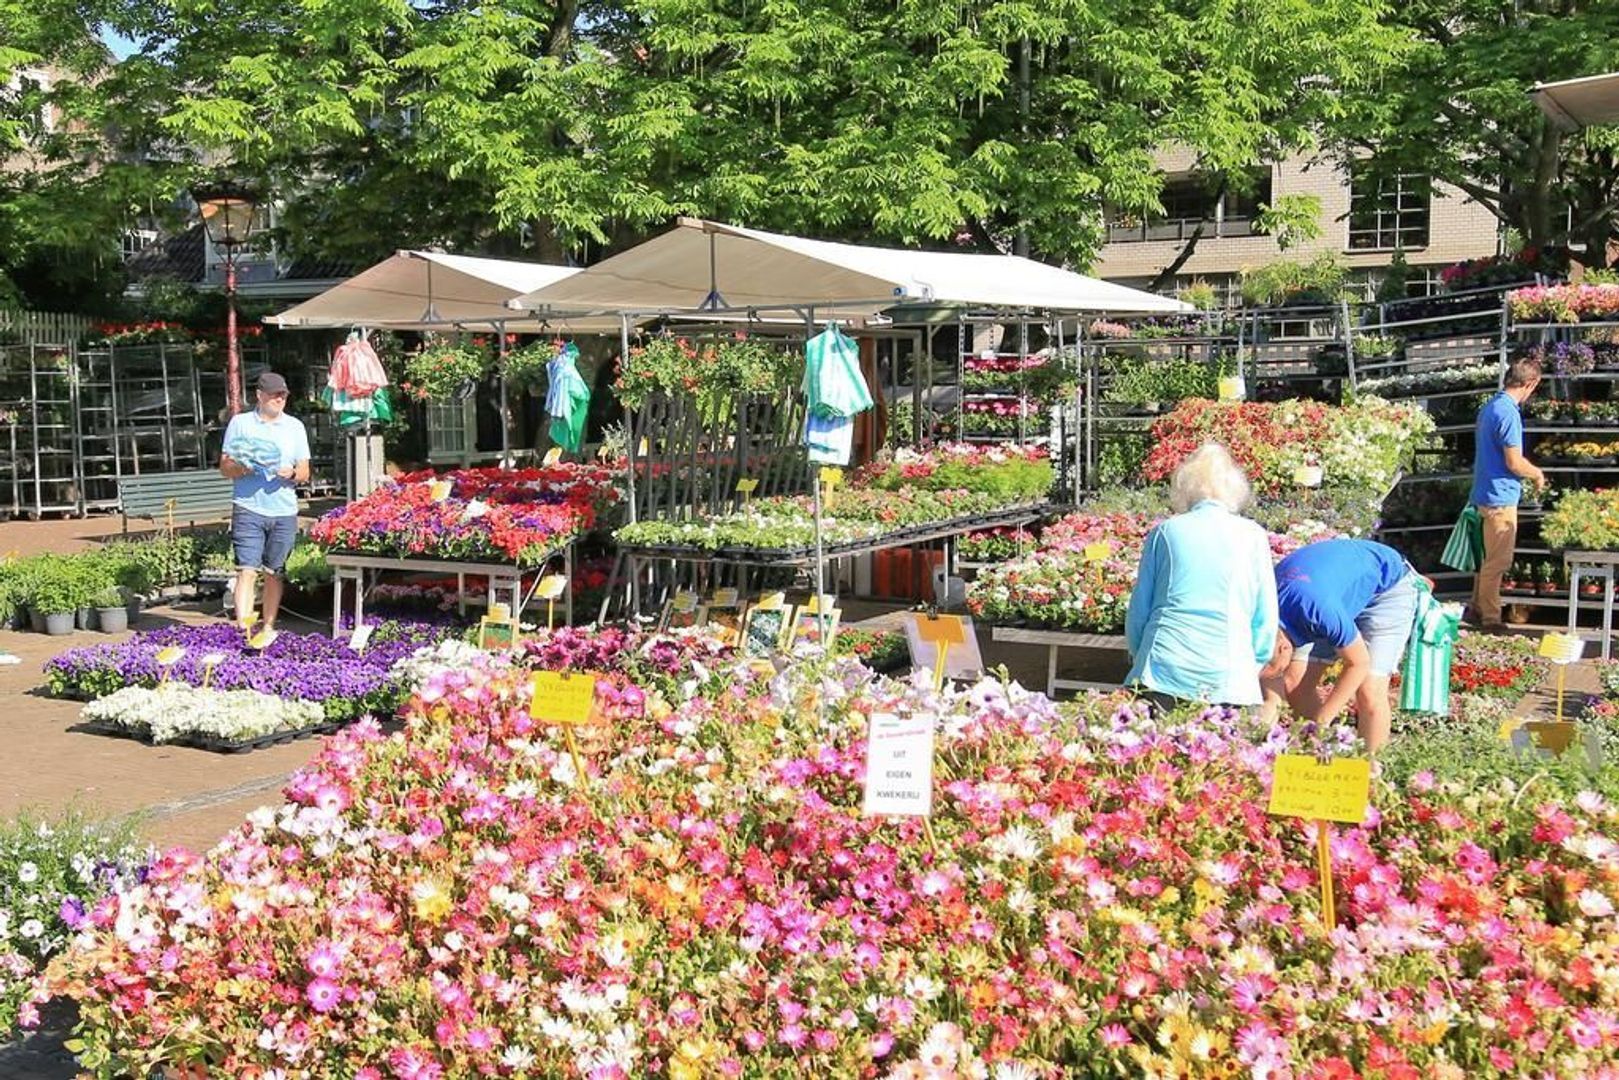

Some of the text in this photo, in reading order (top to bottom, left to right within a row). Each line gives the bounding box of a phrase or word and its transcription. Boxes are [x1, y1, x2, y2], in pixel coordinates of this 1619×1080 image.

[893, 750, 906, 758] UIT
[886, 770, 912, 778] EIGEN
[876, 790, 920, 799] KWEKERIJ
